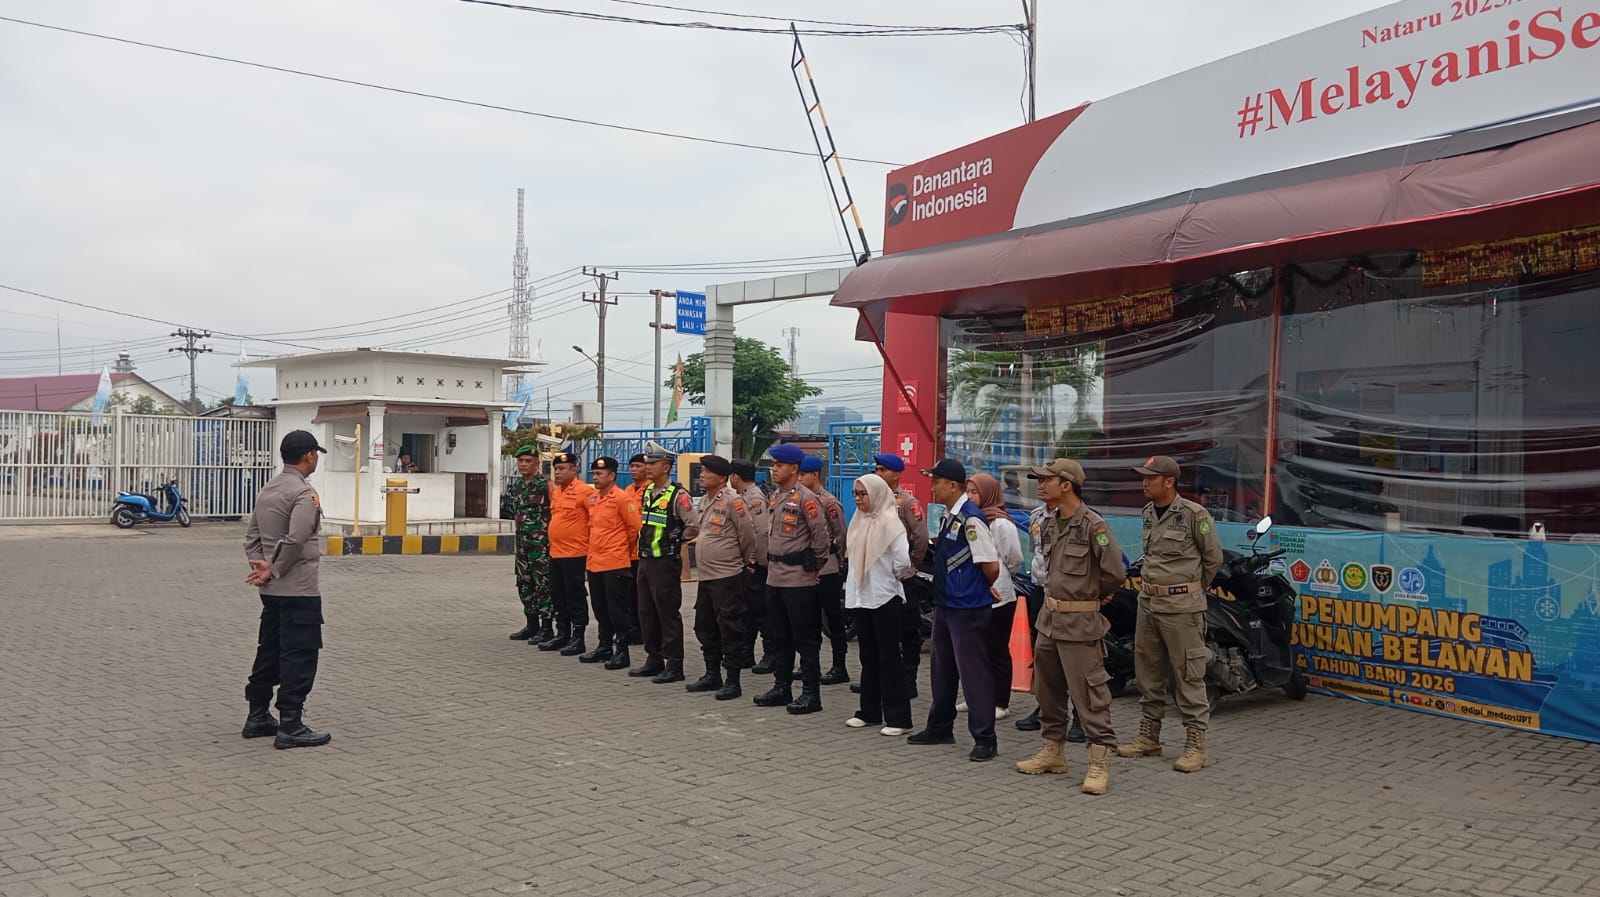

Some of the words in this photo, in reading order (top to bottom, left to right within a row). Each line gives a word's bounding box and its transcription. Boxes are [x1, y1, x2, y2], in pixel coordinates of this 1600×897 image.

[1361, 11, 1442, 48] Nataru
[913, 157, 992, 197] Danantara
[912, 183, 987, 221] Indonesia
[678, 297, 694, 306] ANDA
[678, 308, 703, 319] KAWASAN
[682, 321, 695, 330] LALU
[1300, 594, 1482, 643] PENUMPANG
[1312, 655, 1360, 677] TAHUN
[1364, 663, 1406, 685] BARU
[1411, 671, 1456, 693] 2026
[1382, 632, 1533, 682] BELAWAN
